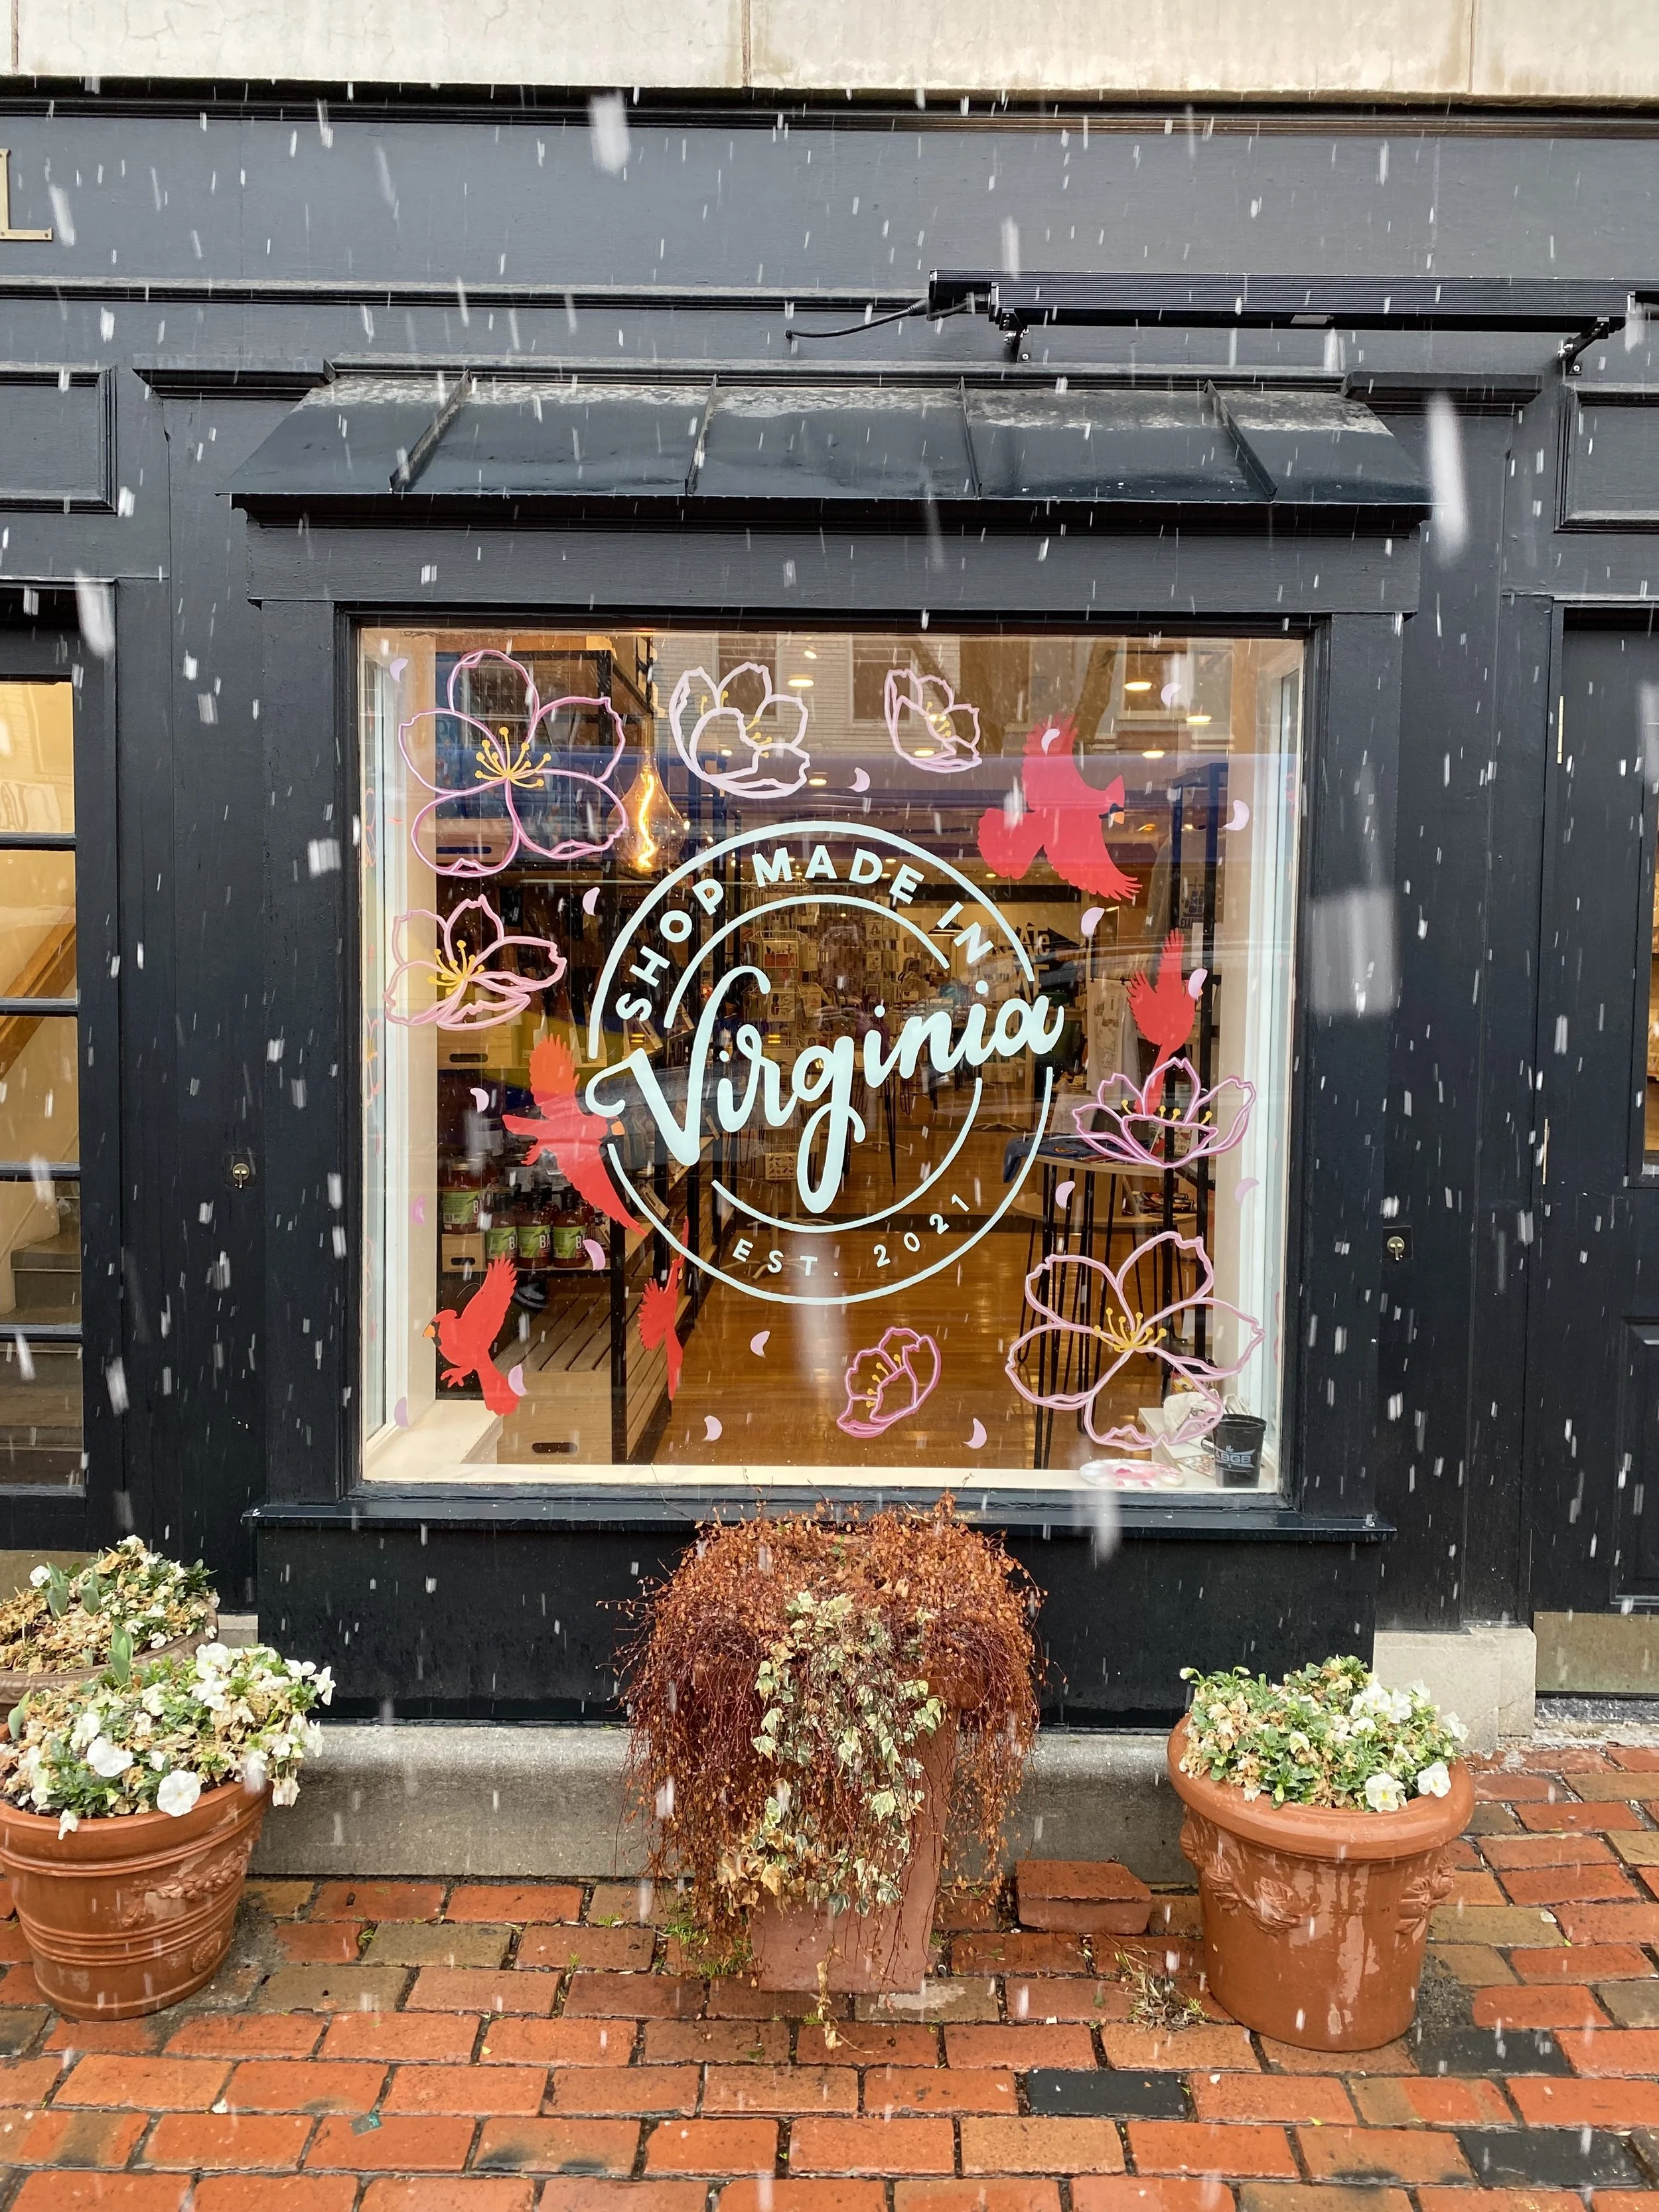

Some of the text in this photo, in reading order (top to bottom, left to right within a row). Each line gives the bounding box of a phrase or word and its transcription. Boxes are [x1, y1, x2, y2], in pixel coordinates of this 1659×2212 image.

[616, 845, 993, 1022] SHOP MADE IN
[584, 965, 1064, 1214] Virginia
[733, 1194, 969, 1276] EST. 2021
[1215, 1449, 1252, 1464] ABGB
